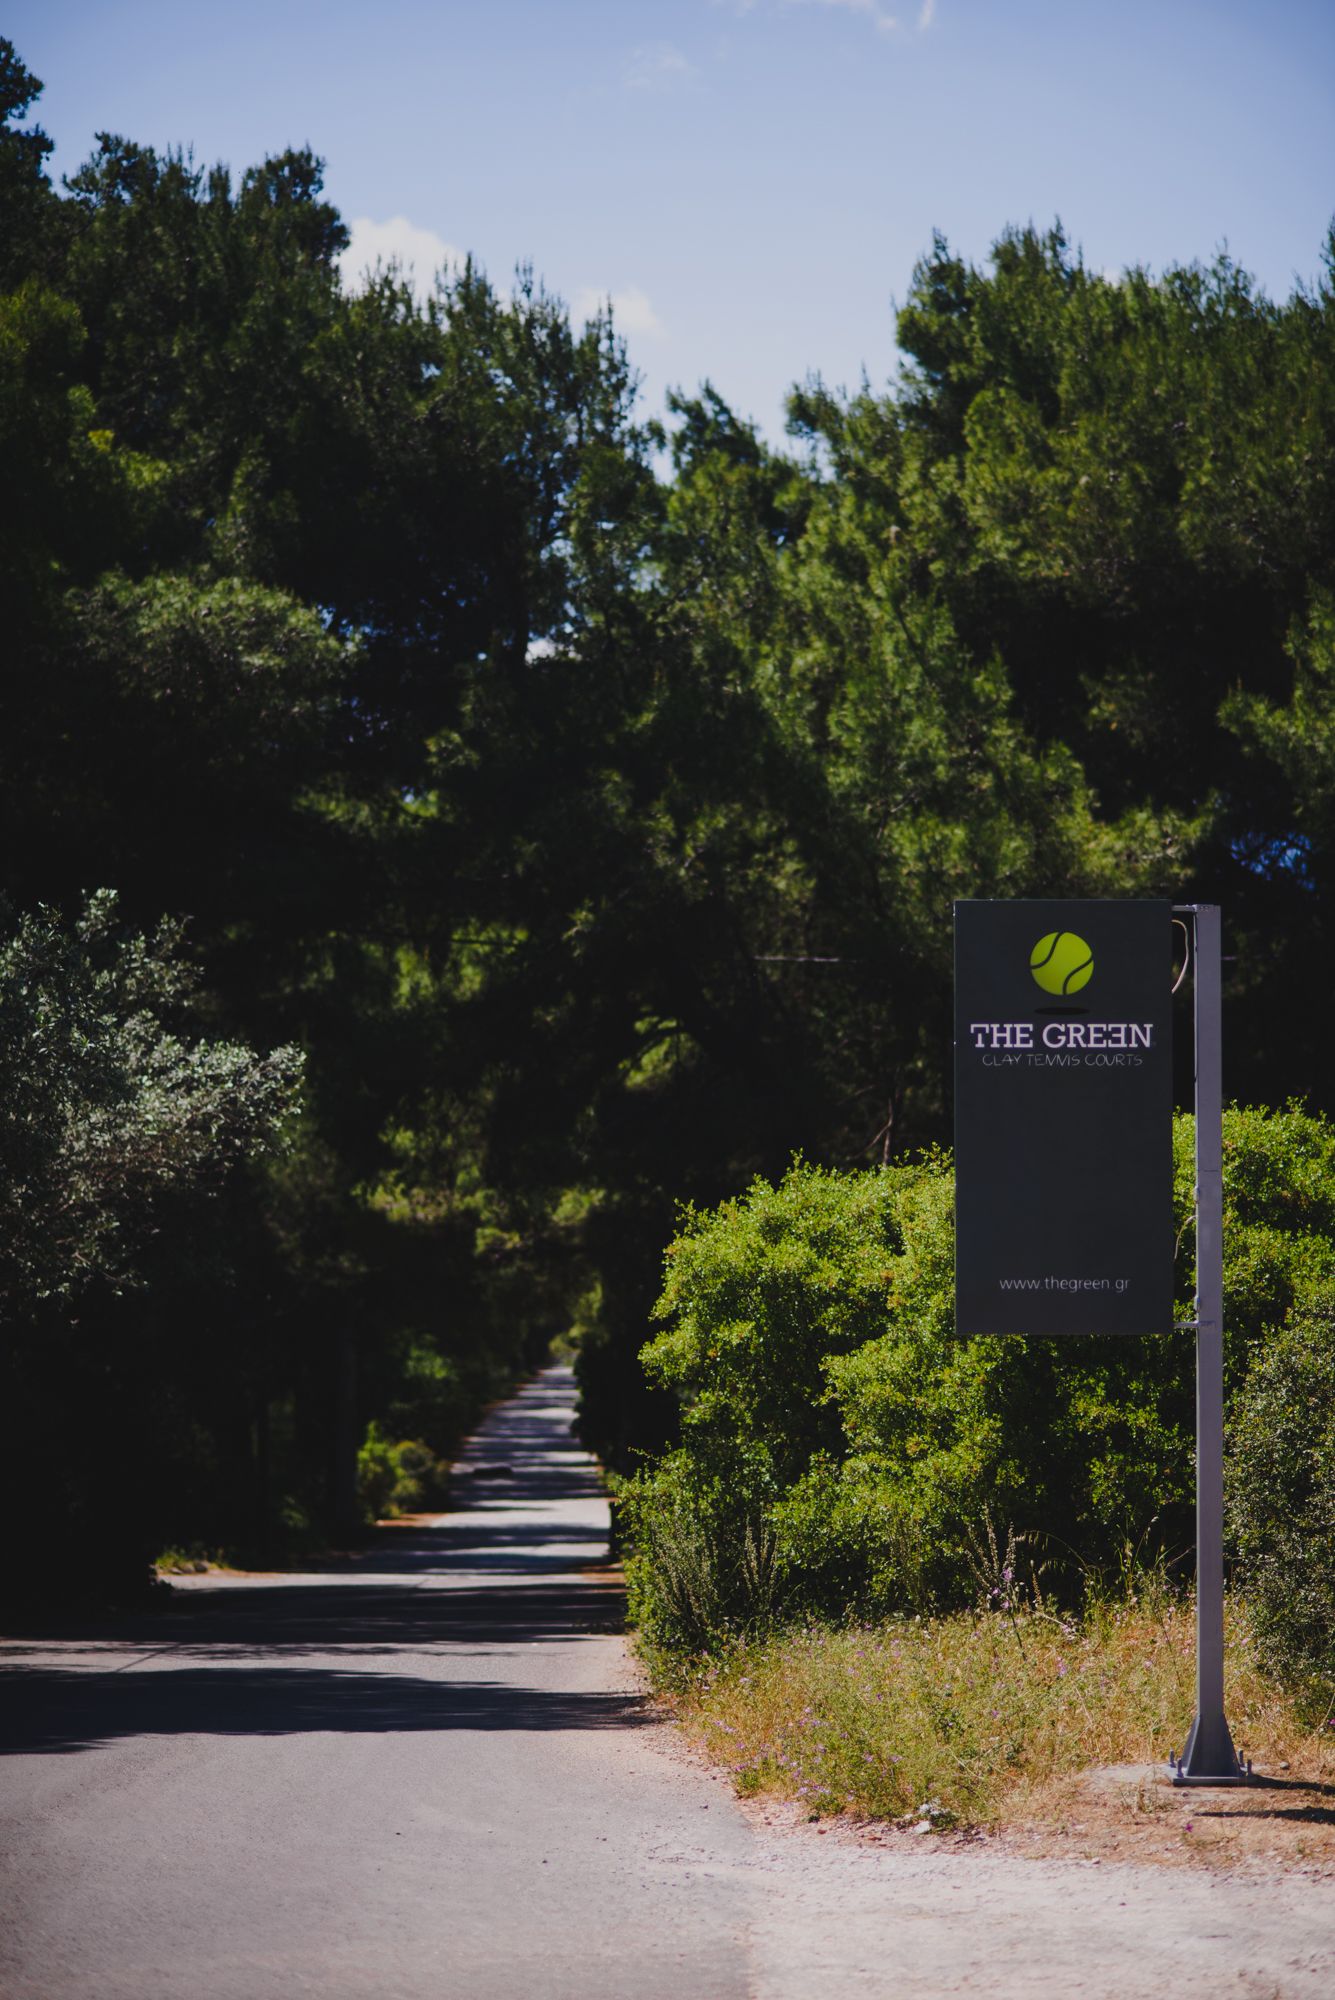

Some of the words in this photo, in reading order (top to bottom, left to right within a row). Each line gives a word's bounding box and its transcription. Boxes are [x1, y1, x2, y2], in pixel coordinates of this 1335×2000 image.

[970, 1023, 1034, 1048] THE
[1042, 1023, 1153, 1048] GREEN
[982, 1053, 1022, 1066] CLAY
[1026, 1053, 1080, 1066] TENNIS
[1084, 1053, 1143, 1066] COURTS
[999, 1275, 1130, 1293] www.thegreen.gr
